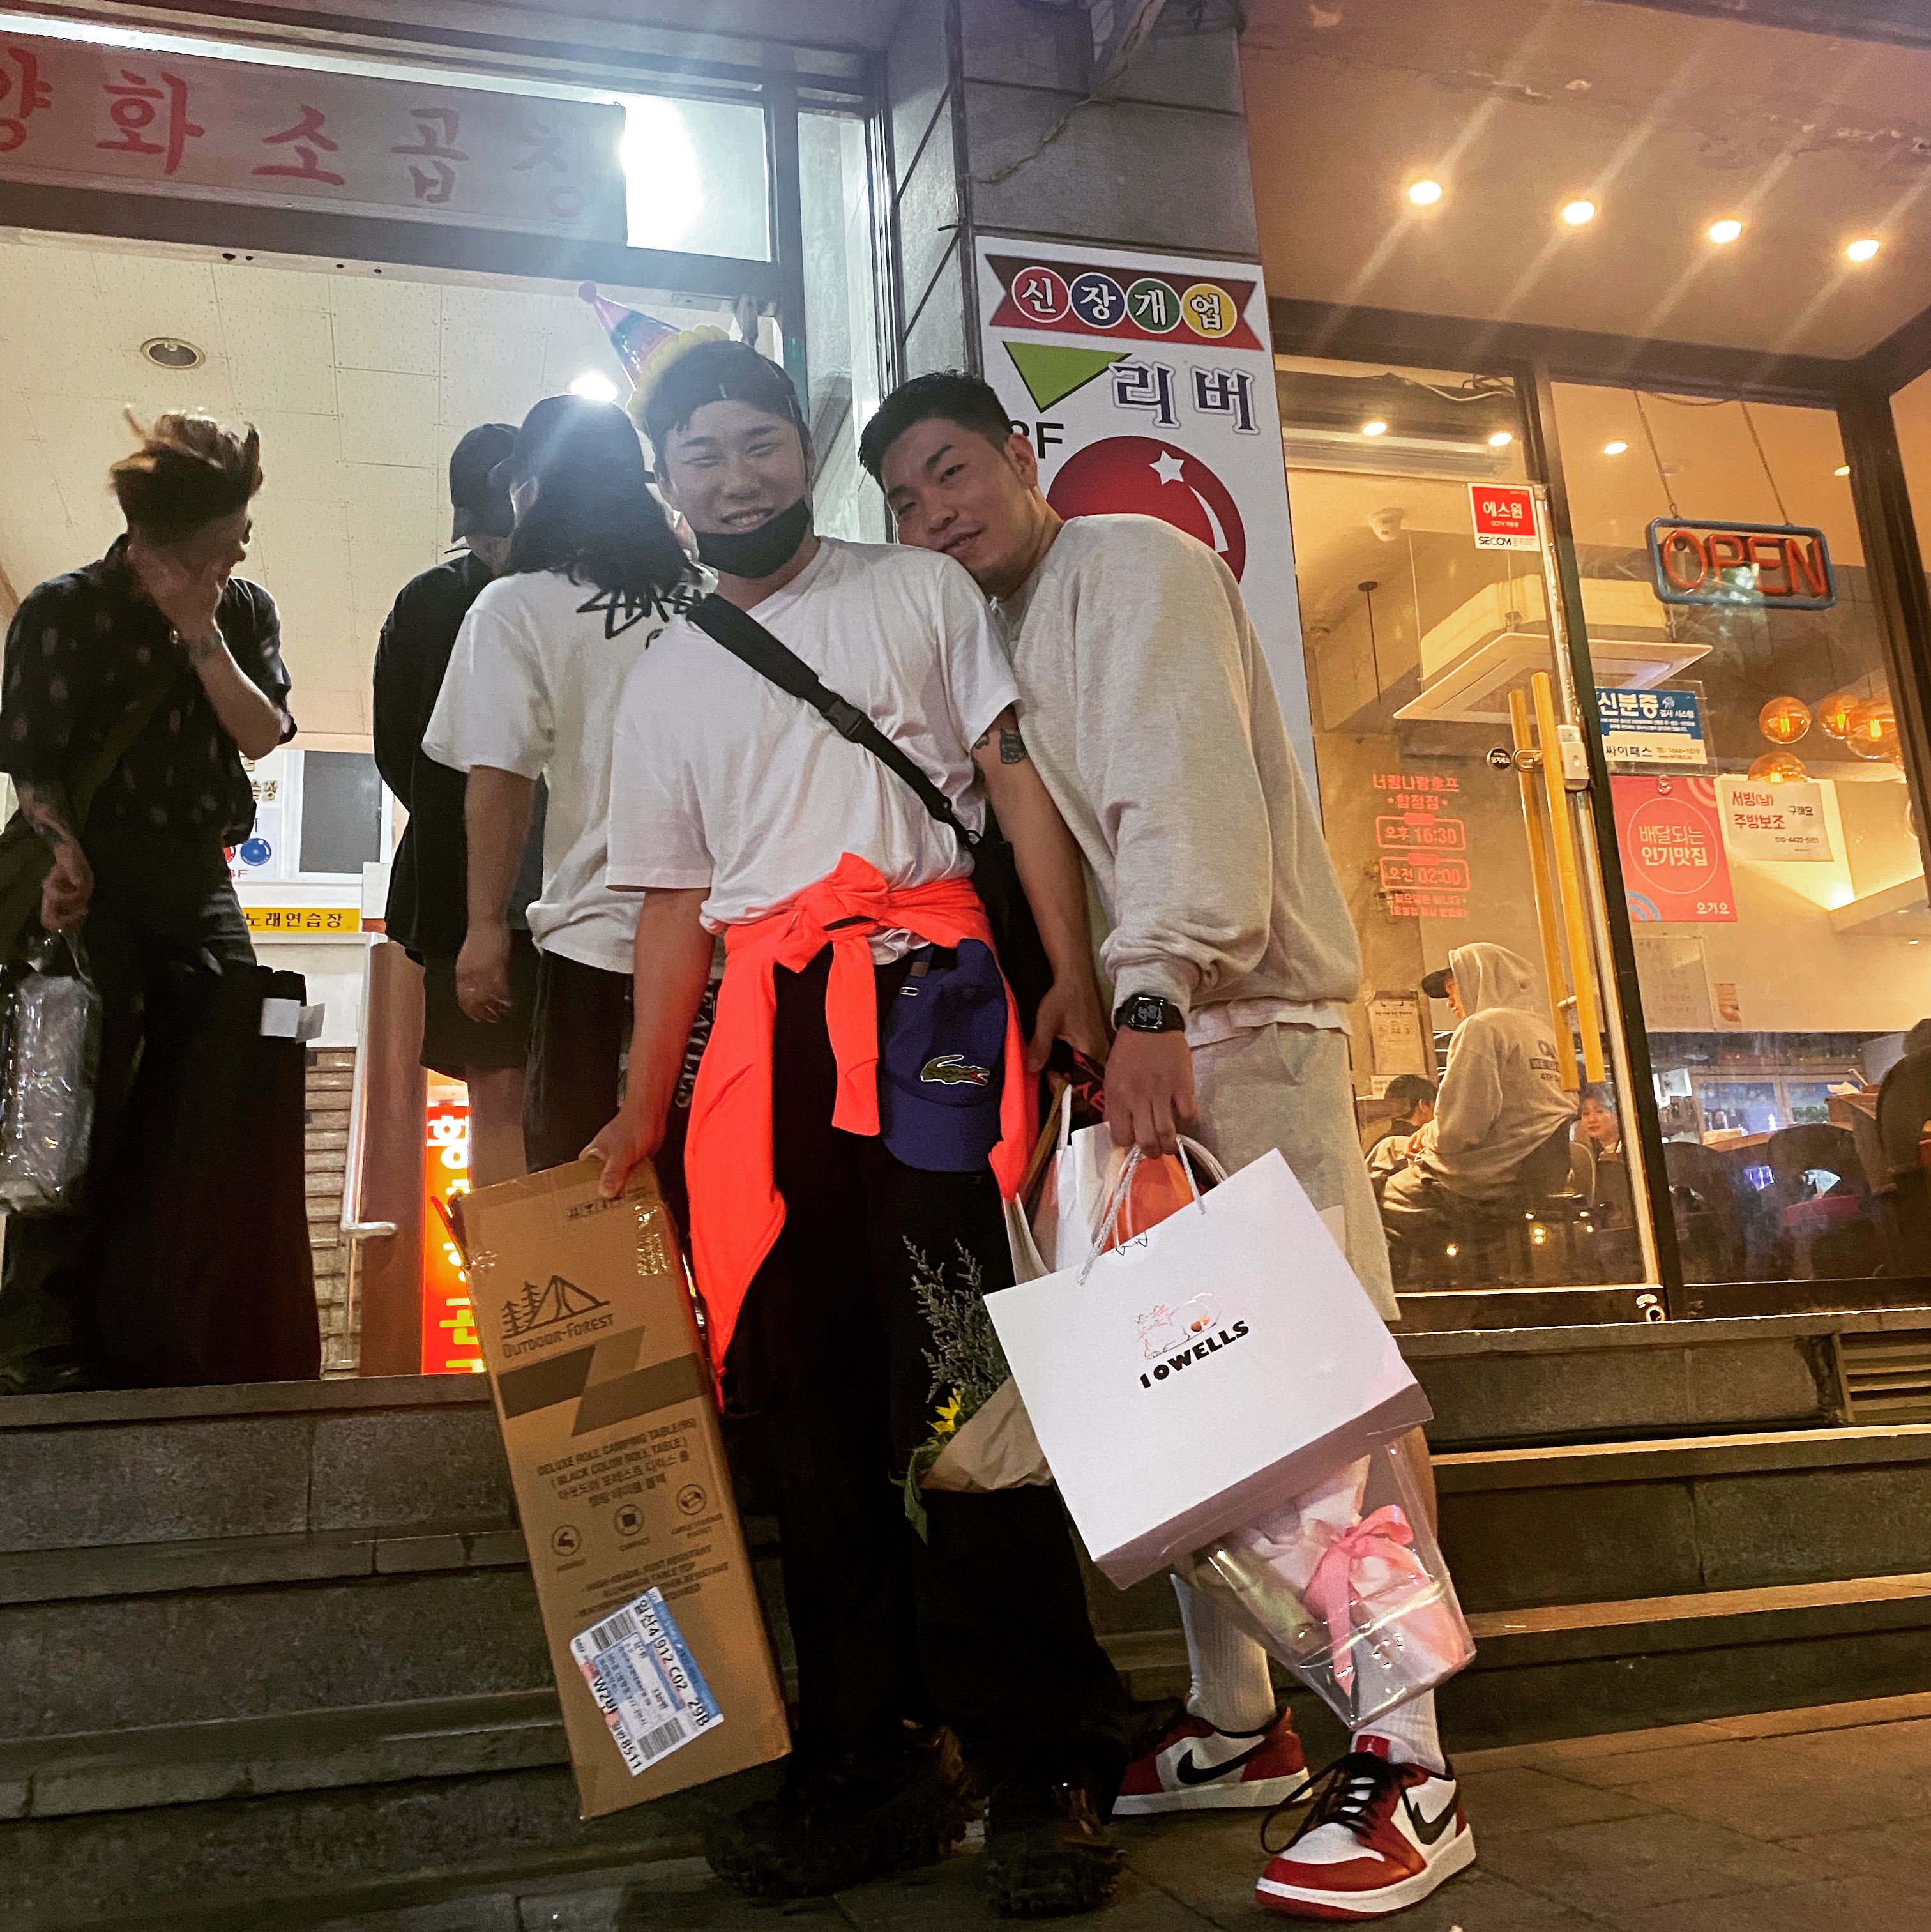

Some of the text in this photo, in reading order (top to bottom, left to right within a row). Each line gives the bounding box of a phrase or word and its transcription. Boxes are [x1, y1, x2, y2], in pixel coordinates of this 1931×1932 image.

[1021, 277, 1222, 330] 신장개업
[1110, 362, 1258, 434] 리버
[1483, 501, 1523, 519] 에스원
[1479, 536, 1511, 546] SECOM
[1663, 529, 1828, 595] OPEN
[1598, 692, 1660, 719] 신분증
[1606, 745, 1653, 757] 싸이패스
[1732, 791, 1774, 807] 서빙(남)
[1734, 814, 1786, 830] 주방보조
[1385, 826, 1457, 844] 오후 16:30
[1639, 825, 1704, 845] 배달되는
[1641, 846, 1708, 867] 인기맛집
[1388, 867, 1461, 885] 오전 02:00
[1697, 902, 1730, 915] 요기요
[245, 912, 344, 928] 노래연습장
[653, 1638, 675, 1665] 912
[667, 1664, 689, 1692] C02
[686, 1696, 712, 1728] 29B
